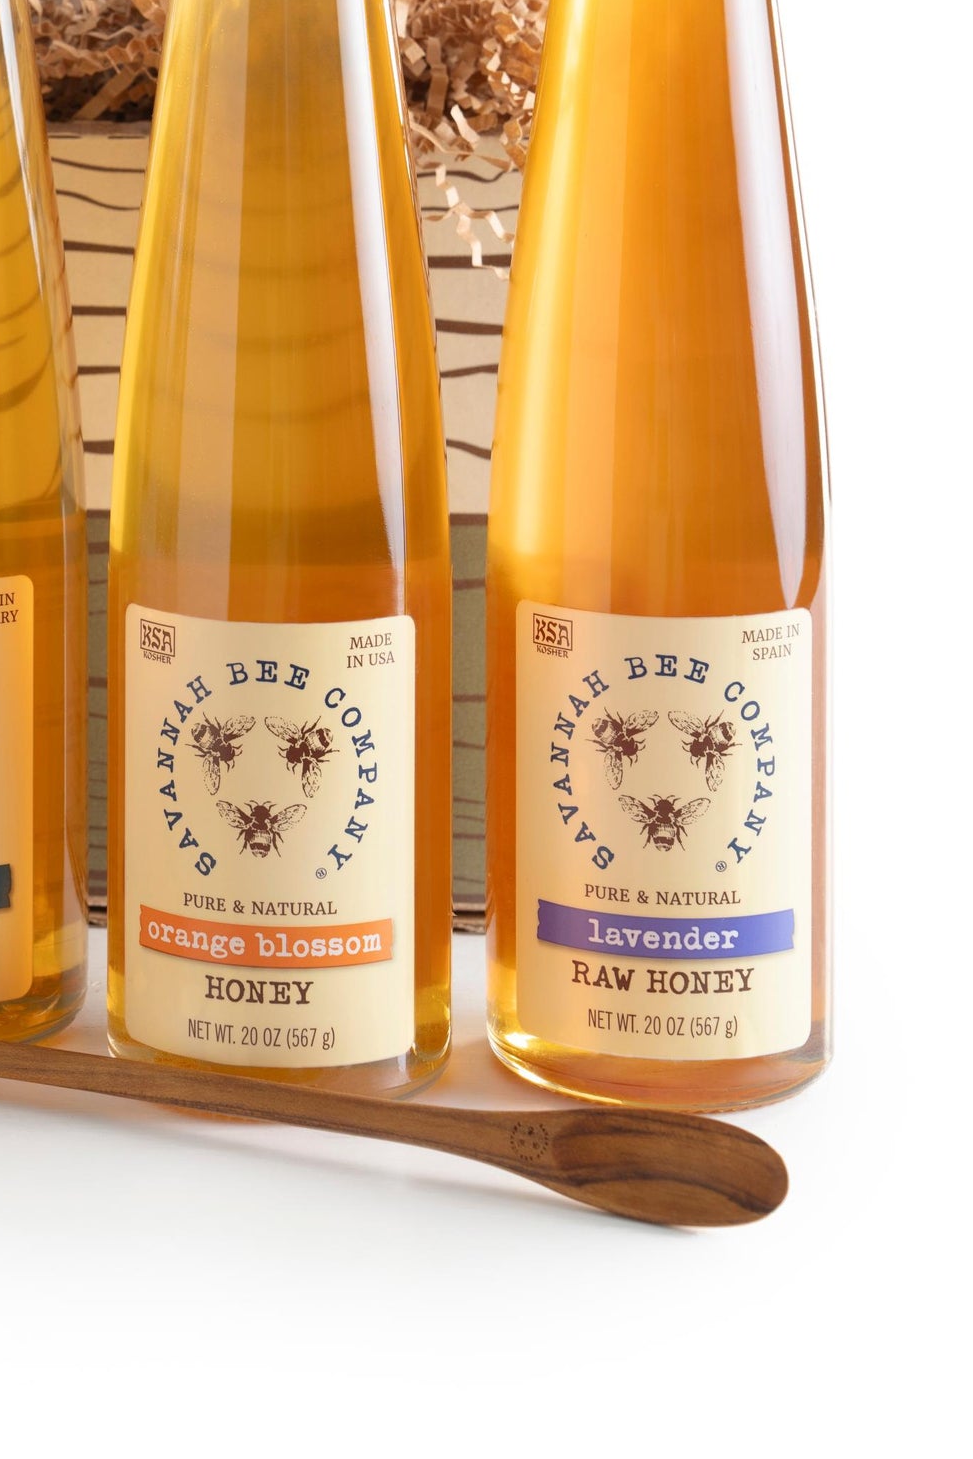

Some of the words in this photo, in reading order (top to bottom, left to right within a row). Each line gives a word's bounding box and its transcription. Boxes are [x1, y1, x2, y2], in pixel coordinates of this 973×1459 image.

[142, 623, 173, 653] KSA
[349, 634, 392, 651] MADE
[535, 618, 570, 647] KSA
[741, 626, 783, 644] MADE
[786, 623, 801, 640] IN
[143, 650, 172, 665] KOSHER
[346, 655, 364, 669] IN
[367, 650, 395, 666] USA
[536, 645, 569, 658] KOSHER
[752, 643, 792, 661] SPAIN
[157, 675, 217, 876] SAVANNAH
[226, 660, 310, 690] BEE
[324, 687, 379, 870] COMPANY
[550, 670, 615, 871] SAVANNAH
[625, 654, 710, 685] BEE
[723, 681, 776, 865] COMPANY
[183, 892, 226, 912] PURE
[233, 900, 245, 914] &
[252, 901, 337, 916] NATURAL
[584, 884, 630, 903] PURE
[637, 891, 649, 905] &
[655, 891, 741, 906] NATURAL
[148, 920, 246, 957] orange
[255, 931, 382, 957] blossom
[587, 918, 739, 950] lavender
[204, 975, 314, 1005] HONEY
[571, 960, 634, 992] RAW
[647, 968, 755, 995] HONEY
[188, 1018, 211, 1041] NET
[215, 1023, 236, 1045] WT.
[241, 1026, 258, 1046] 20
[263, 1028, 281, 1047] OZ
[286, 1028, 318, 1050] (567
[322, 1027, 335, 1050] g)
[588, 1009, 612, 1031] NET
[616, 1012, 639, 1034] WT.
[644, 1016, 662, 1035] 20
[666, 1017, 685, 1036] OZ
[690, 1016, 720, 1038] (567
[725, 1015, 738, 1038] g)
